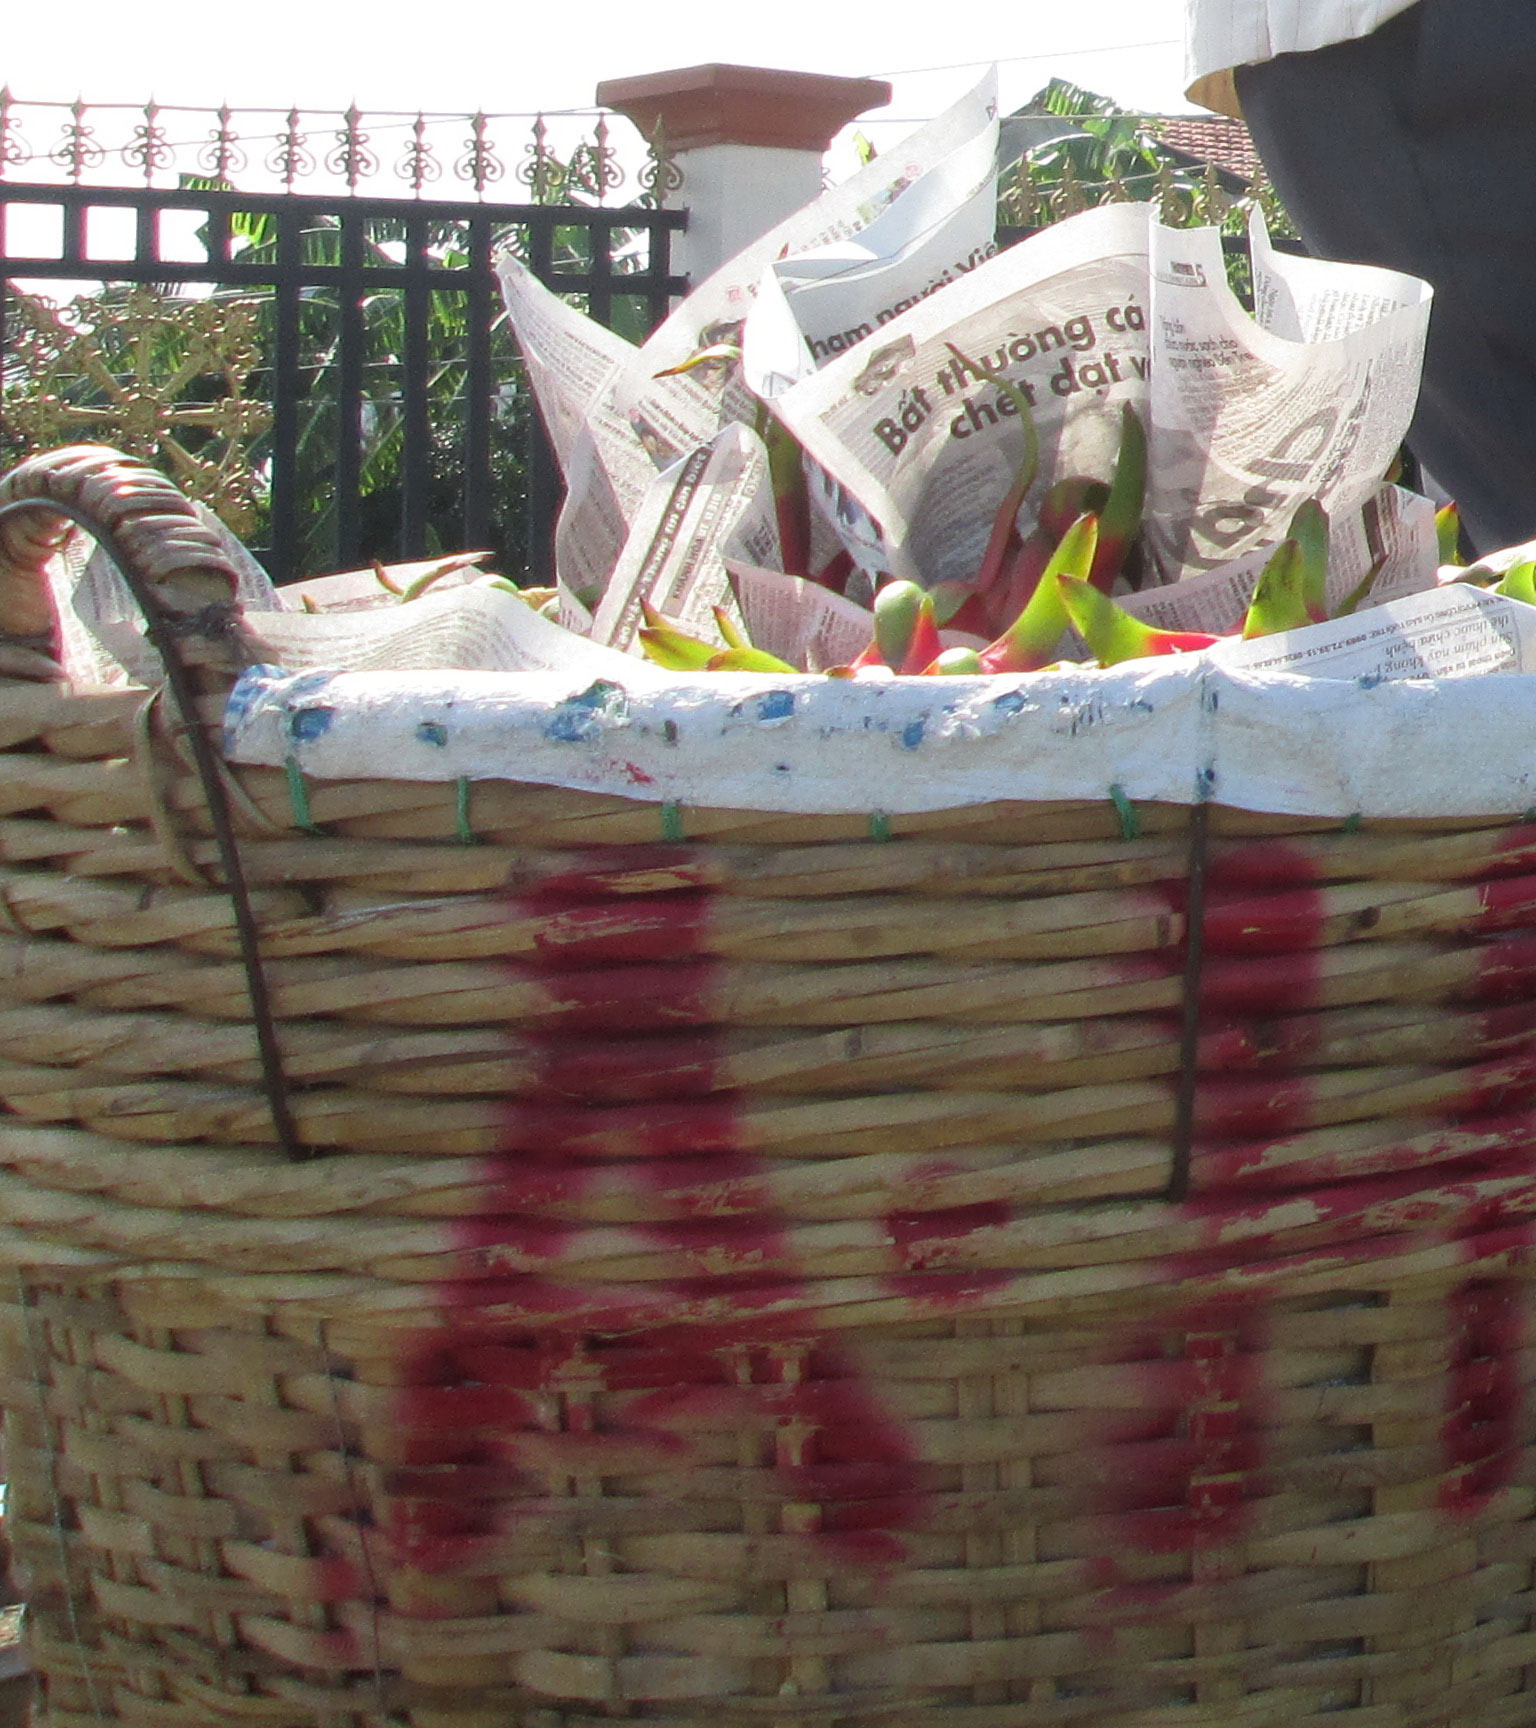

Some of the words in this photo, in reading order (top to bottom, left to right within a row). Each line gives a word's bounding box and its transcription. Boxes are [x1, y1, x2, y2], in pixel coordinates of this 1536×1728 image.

[874, 385, 932, 456] Bất
[937, 315, 1097, 396] thường
[1105, 294, 1145, 334] cá
[949, 378, 1036, 440] chết
[1050, 354, 1124, 399] dạt
